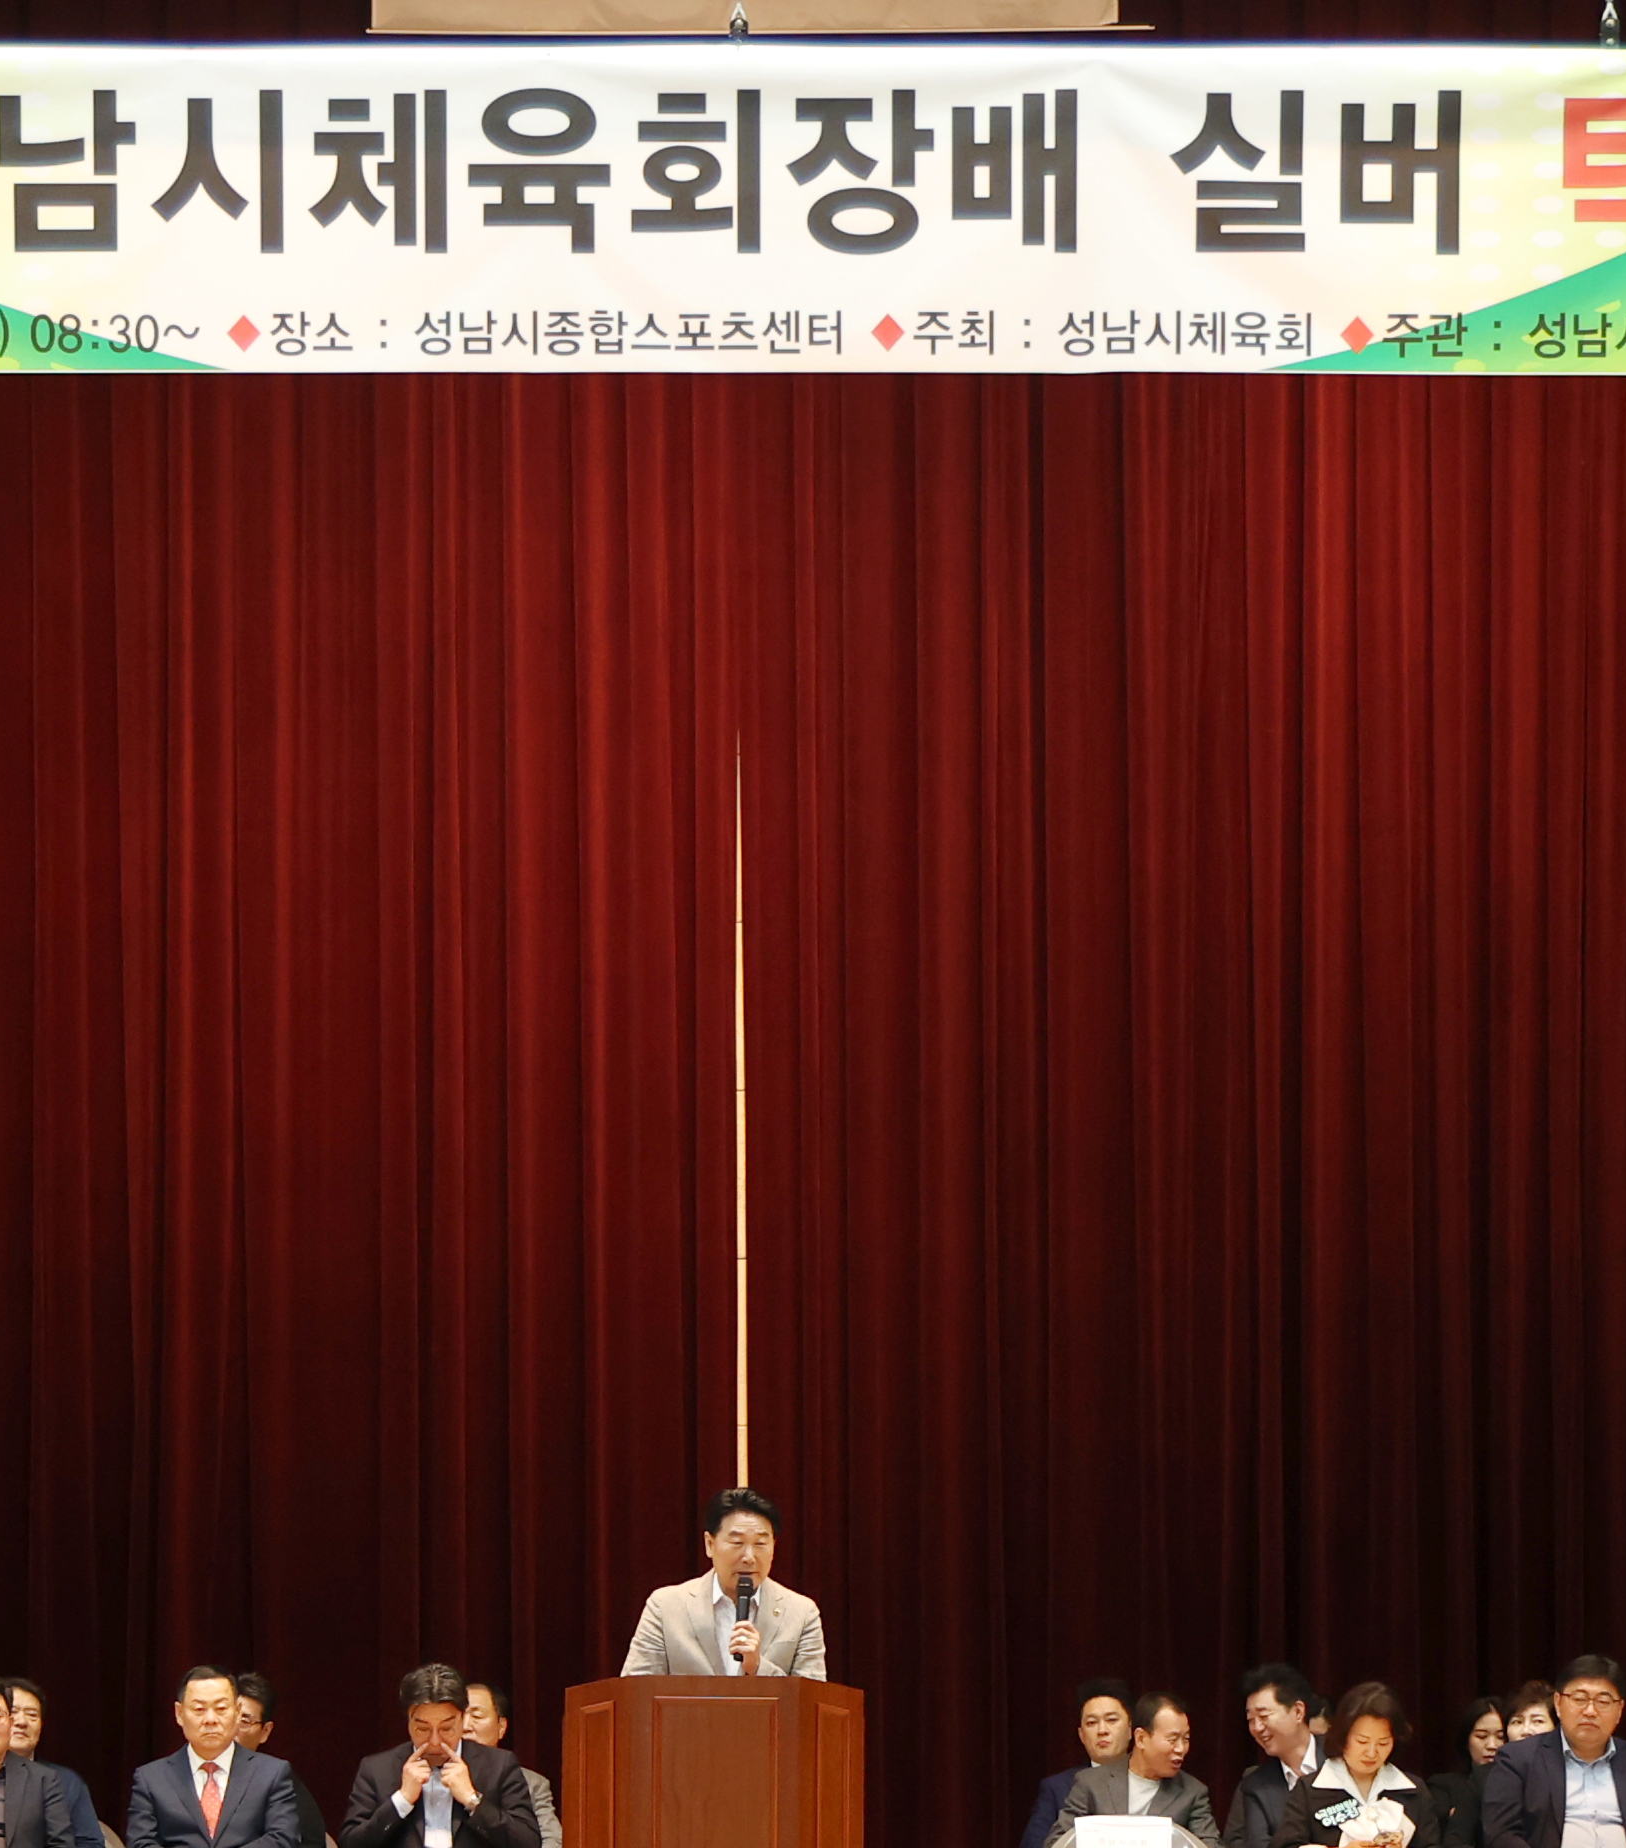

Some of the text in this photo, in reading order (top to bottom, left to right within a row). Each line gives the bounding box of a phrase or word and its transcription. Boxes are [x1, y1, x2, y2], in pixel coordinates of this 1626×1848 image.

[1169, 89, 1462, 255] 실버
[270, 310, 354, 356] 장소
[414, 310, 844, 356] 성남시종합스포츠센터
[911, 310, 997, 356] 주최
[1058, 310, 1313, 357] 성남시체육회
[1381, 311, 1468, 358] 주관
